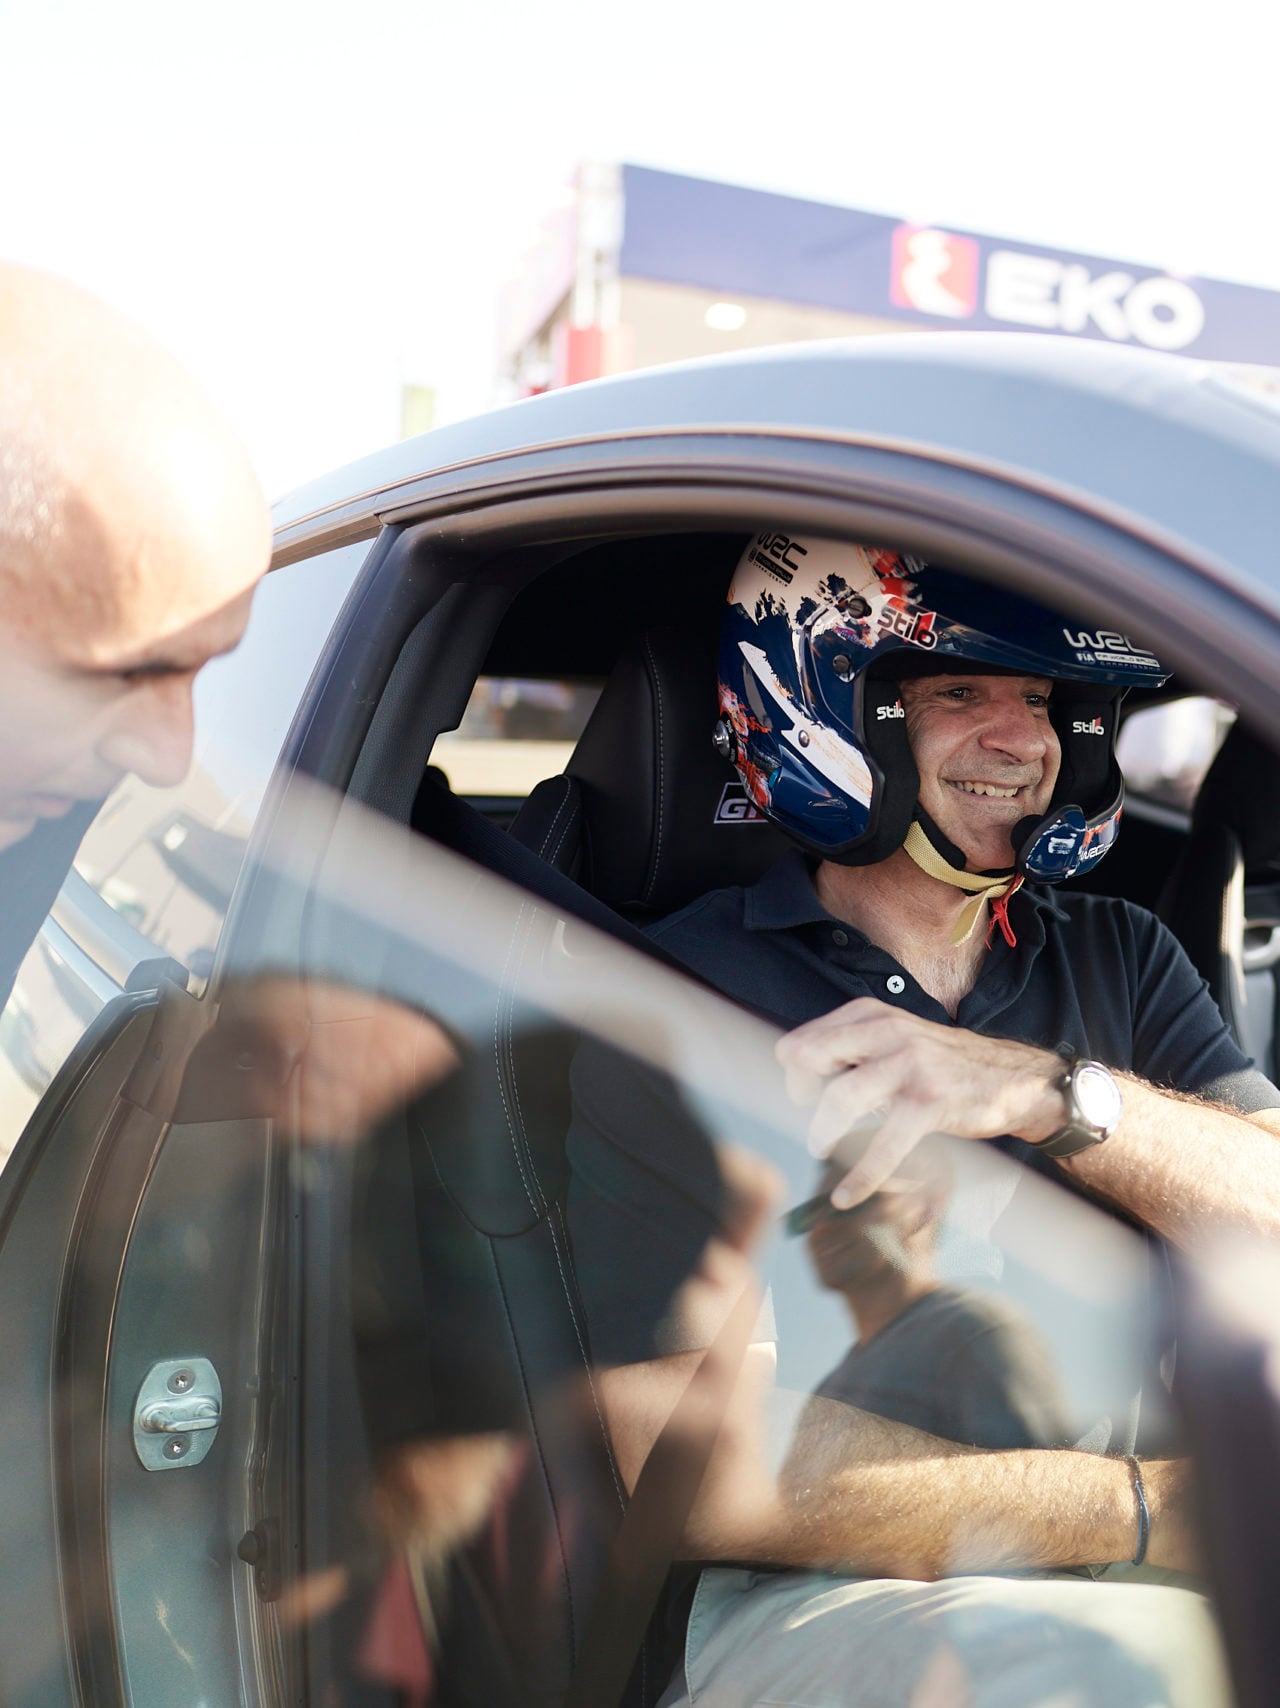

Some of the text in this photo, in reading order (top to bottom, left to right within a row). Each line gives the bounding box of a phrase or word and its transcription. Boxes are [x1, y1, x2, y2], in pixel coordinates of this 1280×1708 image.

[985, 249, 1205, 350] EKO
[877, 604, 937, 648] Stilo
[876, 699, 905, 720] Stilo
[1072, 717, 1104, 735] Stilo
